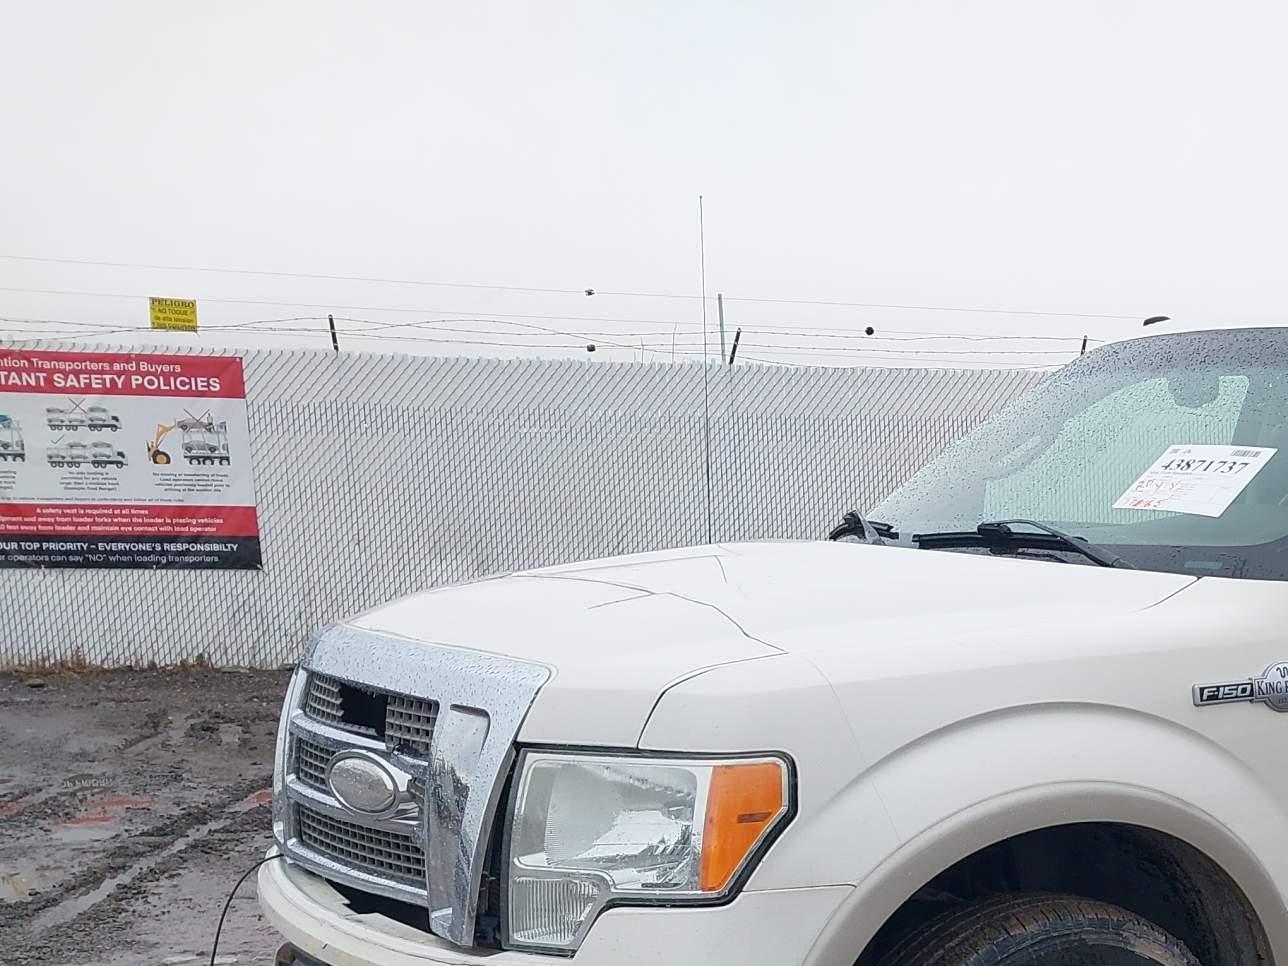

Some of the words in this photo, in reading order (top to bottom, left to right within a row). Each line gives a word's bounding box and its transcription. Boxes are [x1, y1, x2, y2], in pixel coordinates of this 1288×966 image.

[31, 357, 110, 371] Transporters
[113, 361, 136, 371] and
[139, 361, 181, 374] Buyers
[53, 373, 125, 389] SAFETY
[131, 375, 221, 391] POLICIES
[1161, 458, 1250, 474] 43871737
[20, 542, 40, 550] TOP
[43, 542, 88, 550] PRIORITY
[97, 543, 162, 551] EVERYONE'S
[163, 543, 239, 551] RESPONSIBILTY
[8, 554, 49, 562] operators
[108, 554, 133, 562] when
[134, 554, 167, 564] loading
[1257, 680, 1282, 696] KING
